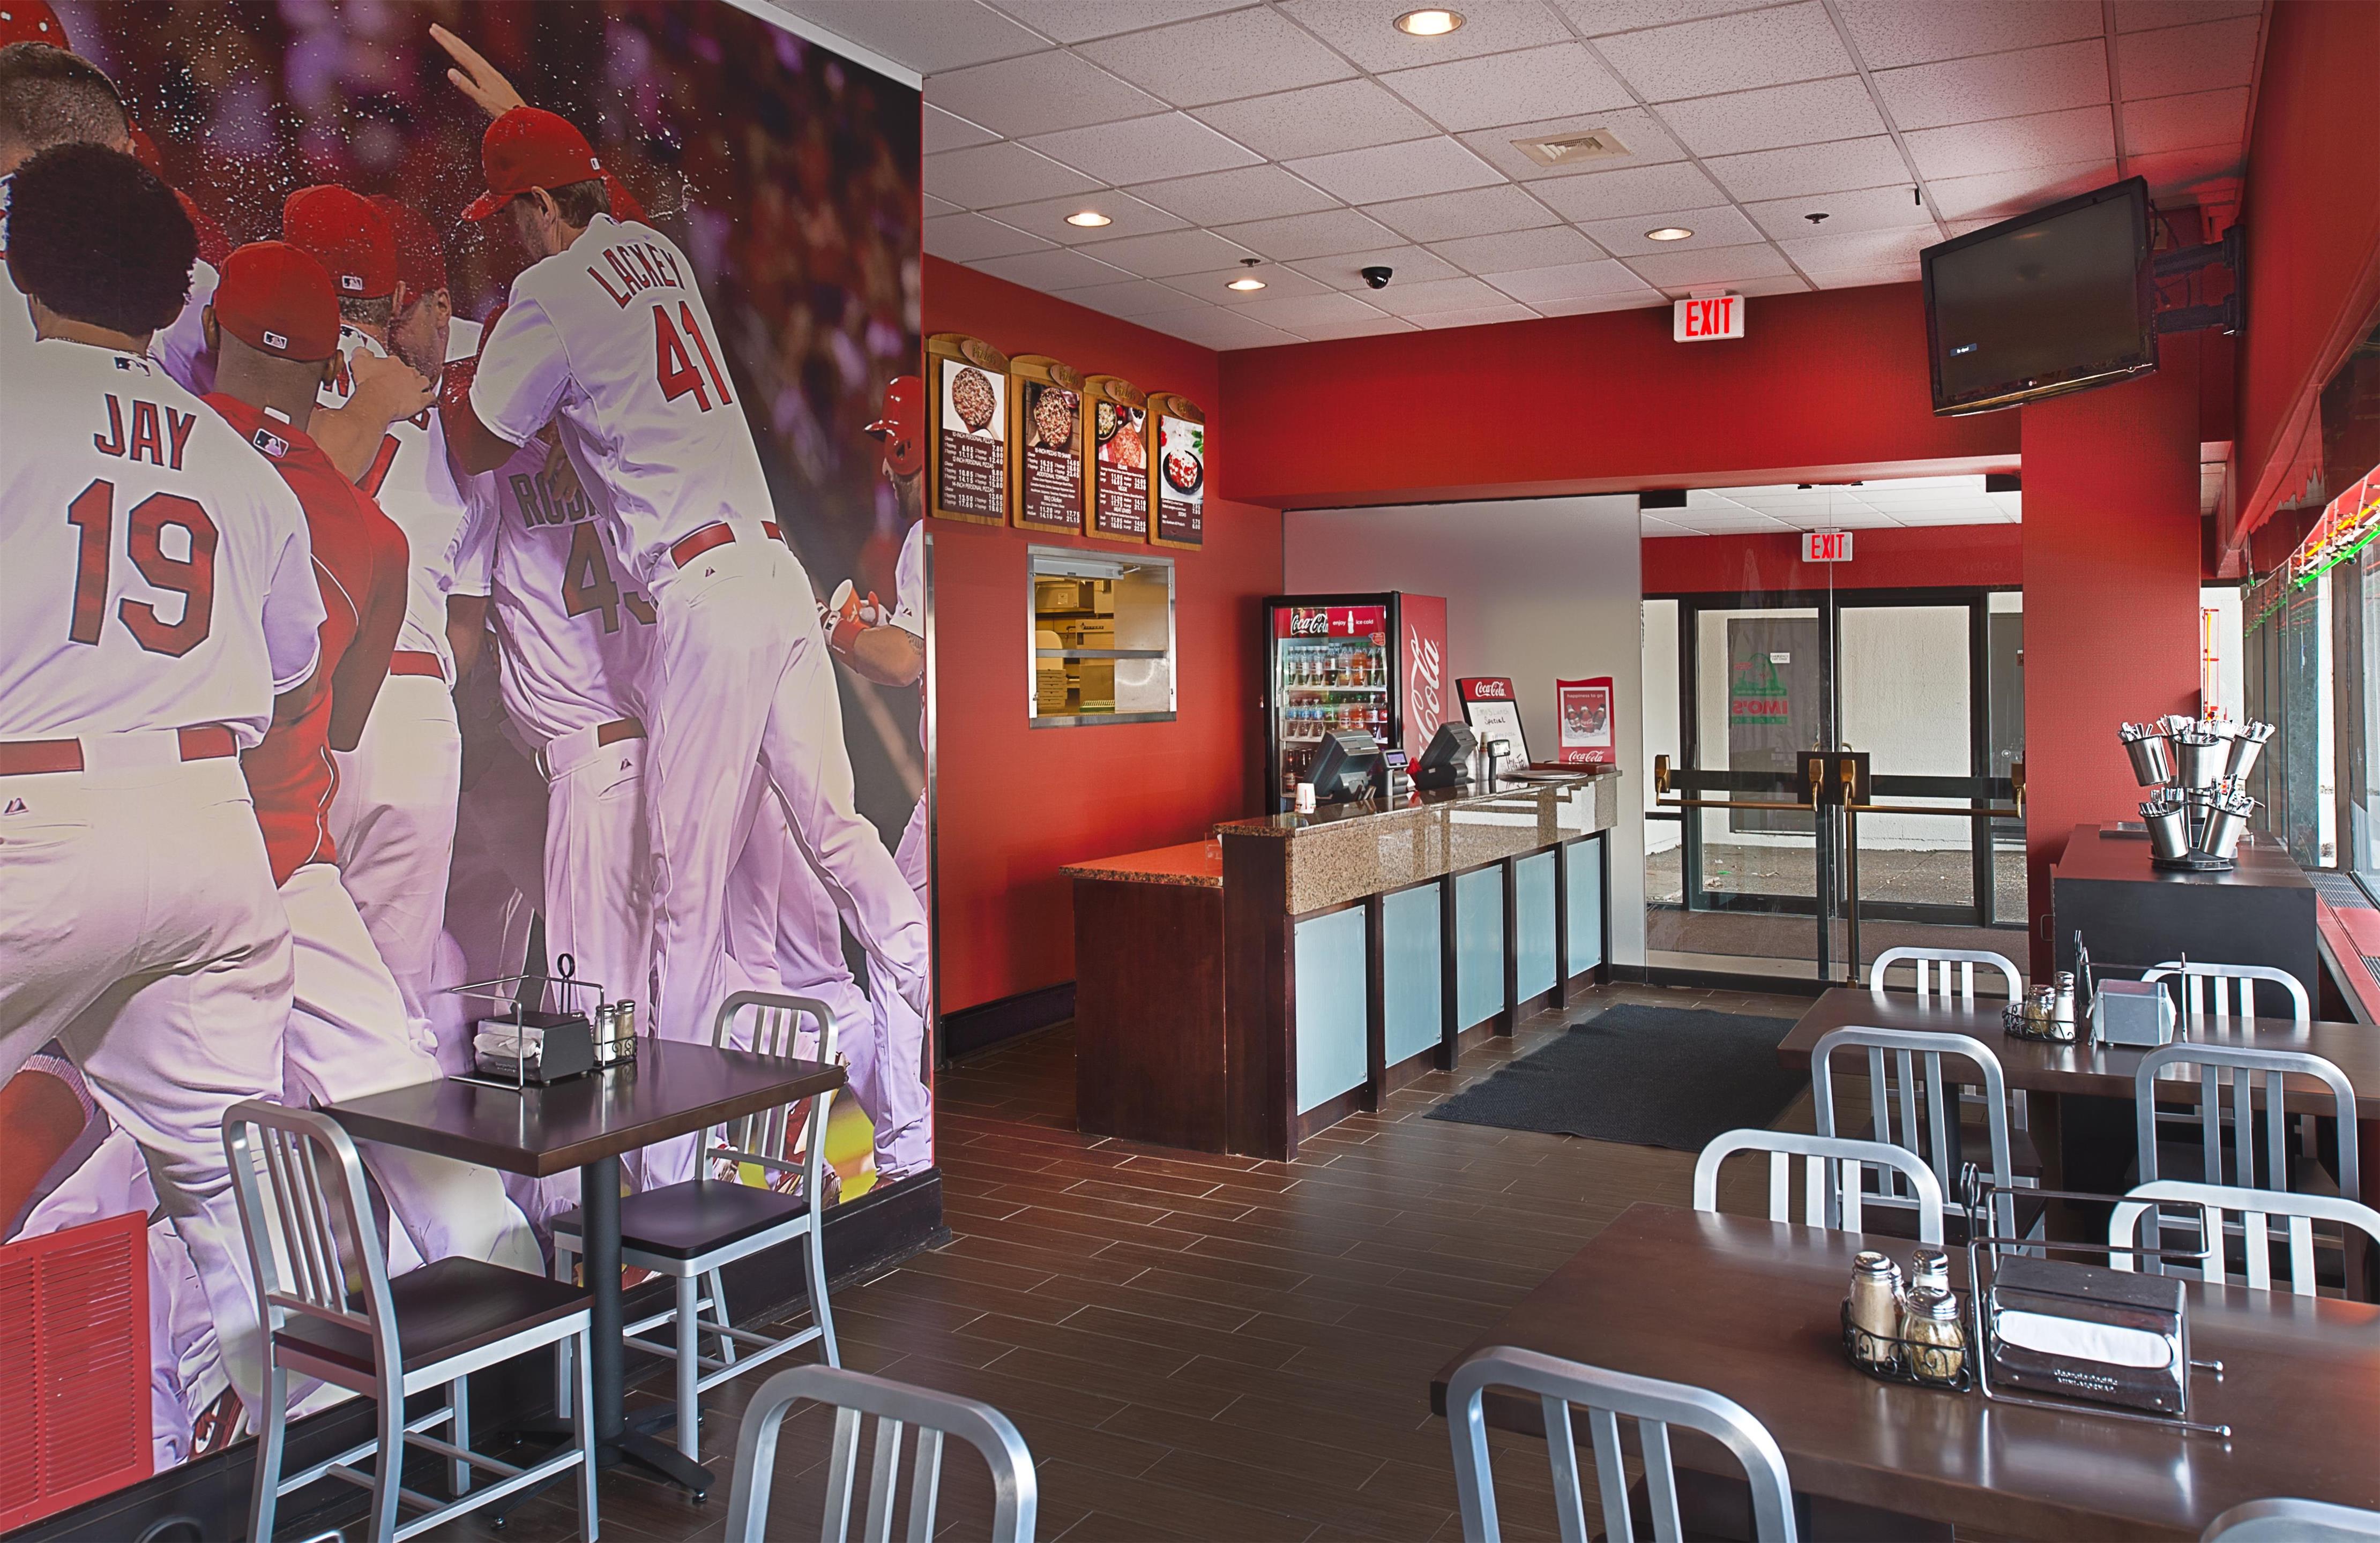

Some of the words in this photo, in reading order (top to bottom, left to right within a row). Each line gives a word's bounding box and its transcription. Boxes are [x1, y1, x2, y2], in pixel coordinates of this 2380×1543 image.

[587, 243, 685, 309] LACKEY
[1686, 298, 1734, 336] EXIT
[652, 300, 733, 413] 41
[94, 393, 196, 470] JAY
[1811, 534, 1845, 559] EXIT
[68, 478, 219, 658] 19
[1292, 613, 1329, 635] Coca-Cola
[1475, 681, 1504, 697] Coca-Cola
[1569, 751, 1604, 762] Coca-Cola
